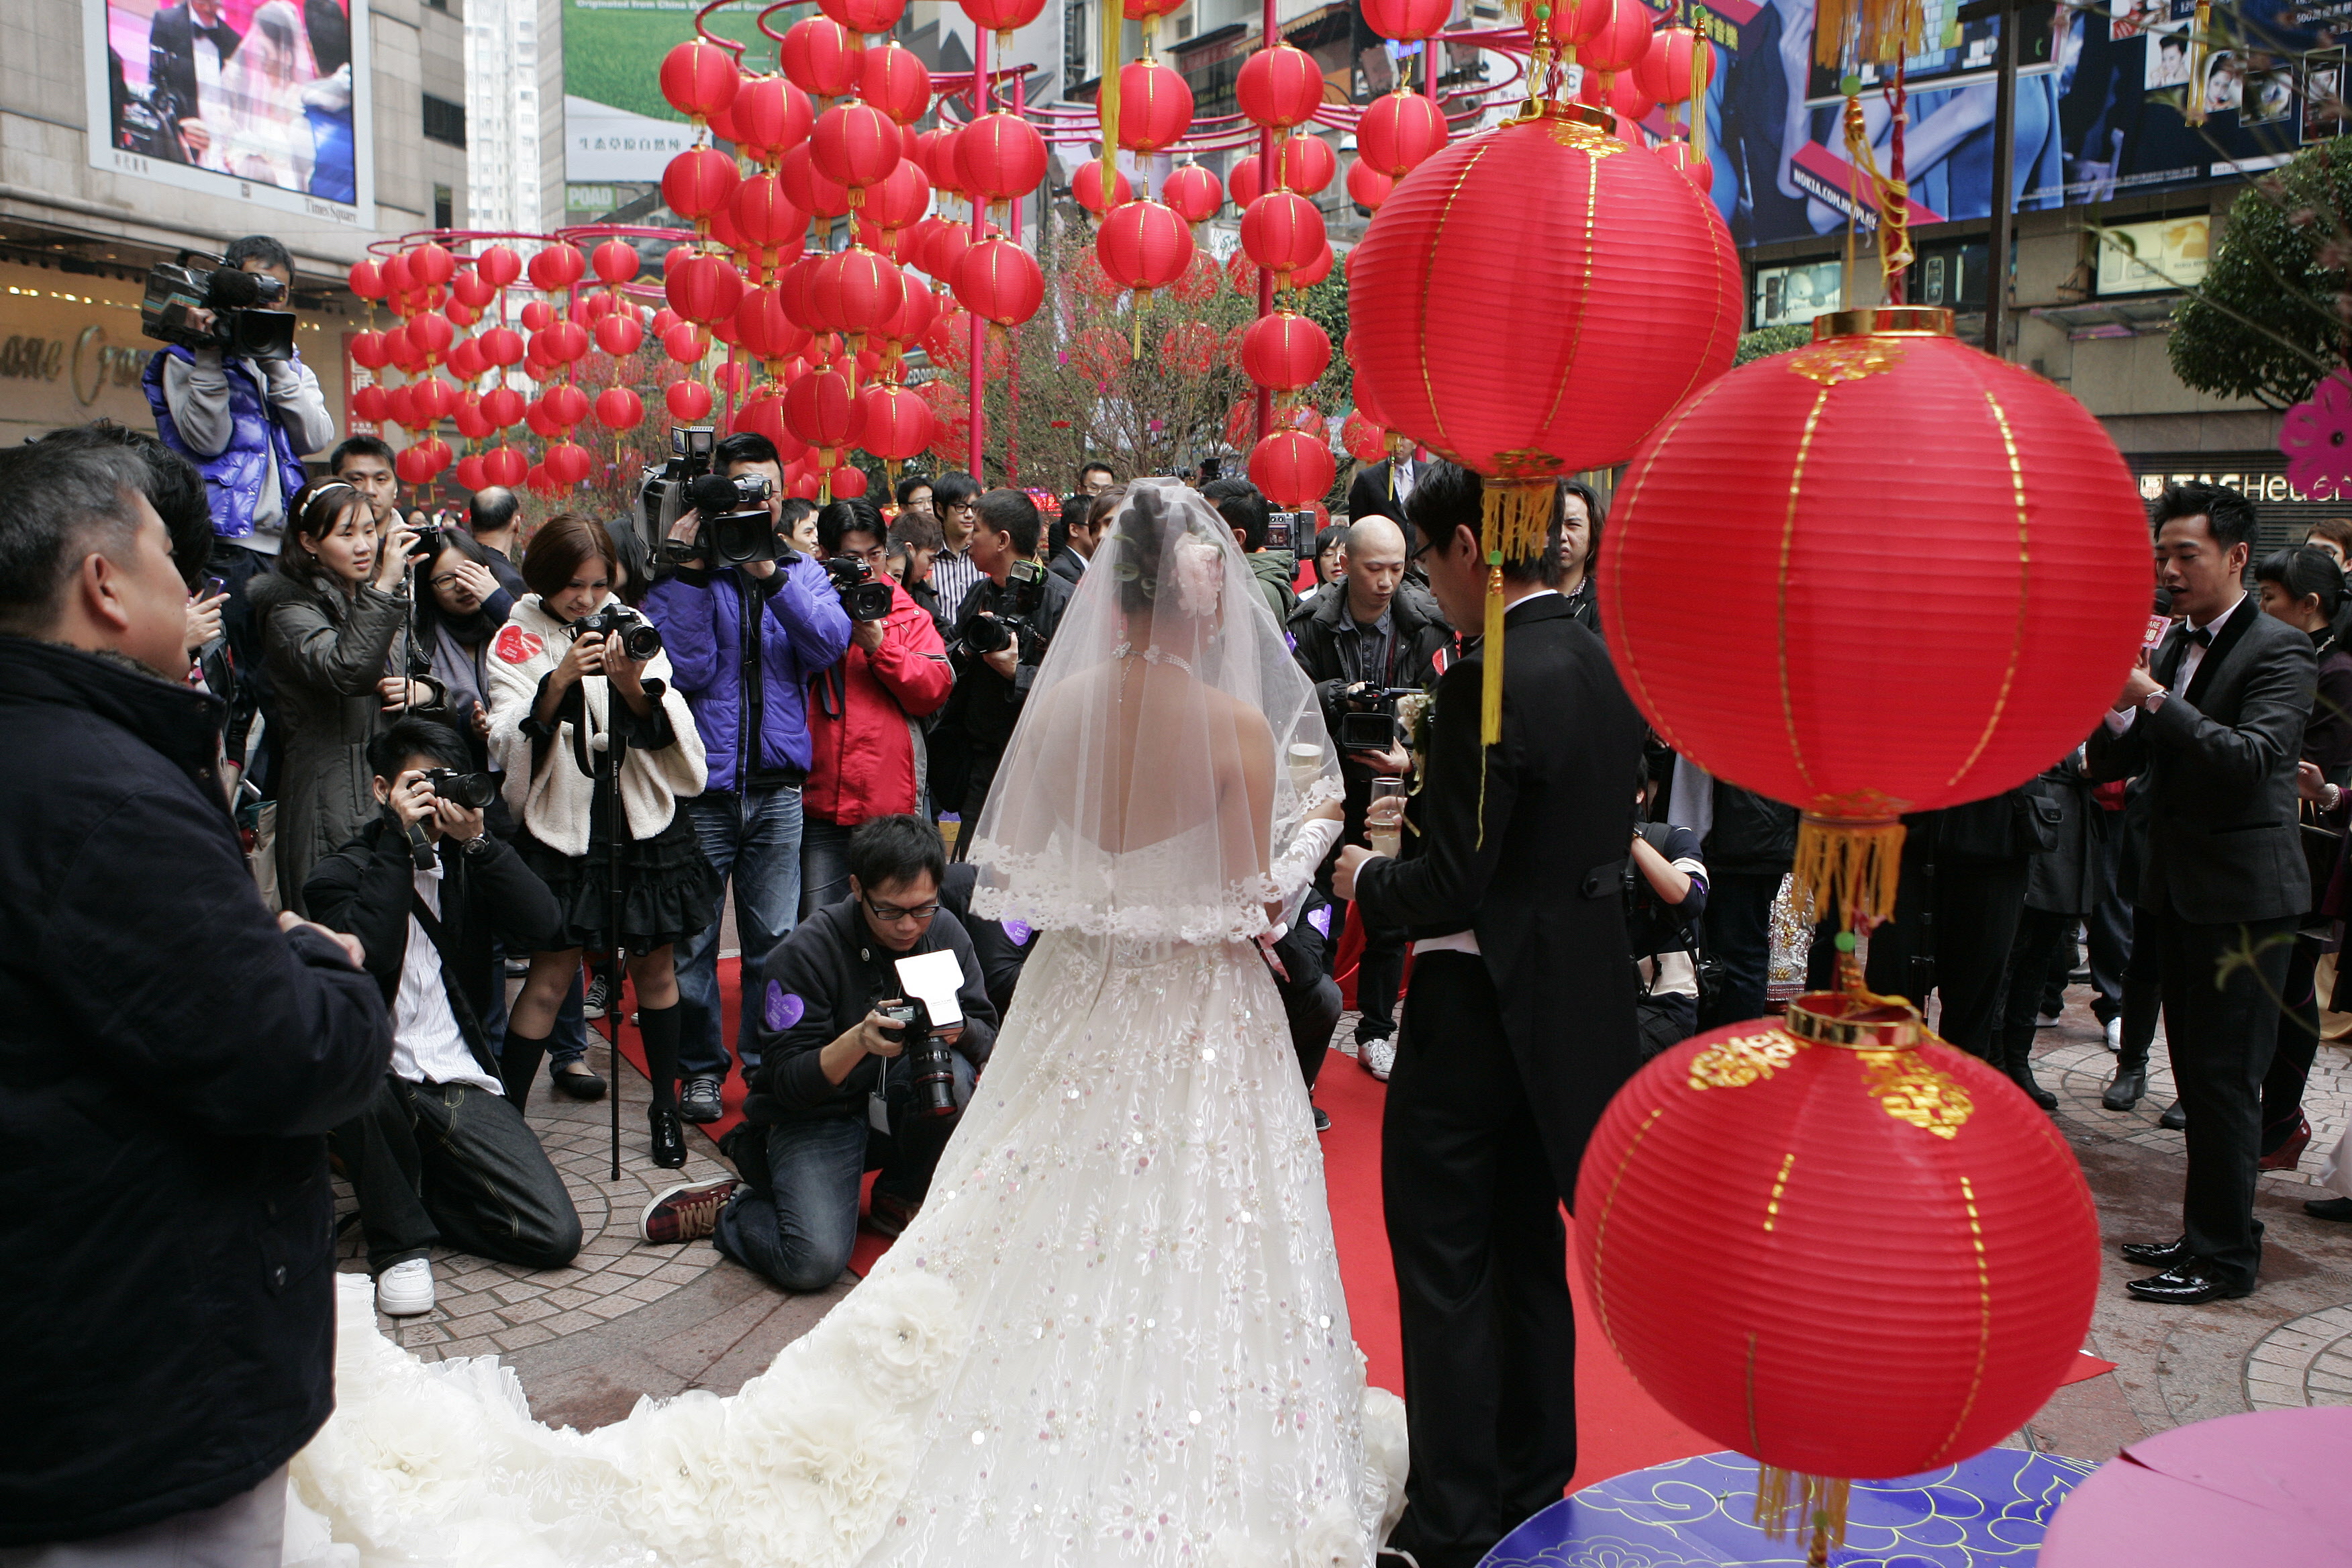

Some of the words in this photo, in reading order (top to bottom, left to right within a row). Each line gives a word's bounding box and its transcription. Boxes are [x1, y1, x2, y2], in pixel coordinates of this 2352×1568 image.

[569, 187, 614, 206] POAD
[305, 197, 330, 217] Times
[330, 203, 358, 224] Square
[2148, 620, 2161, 630] ARE
